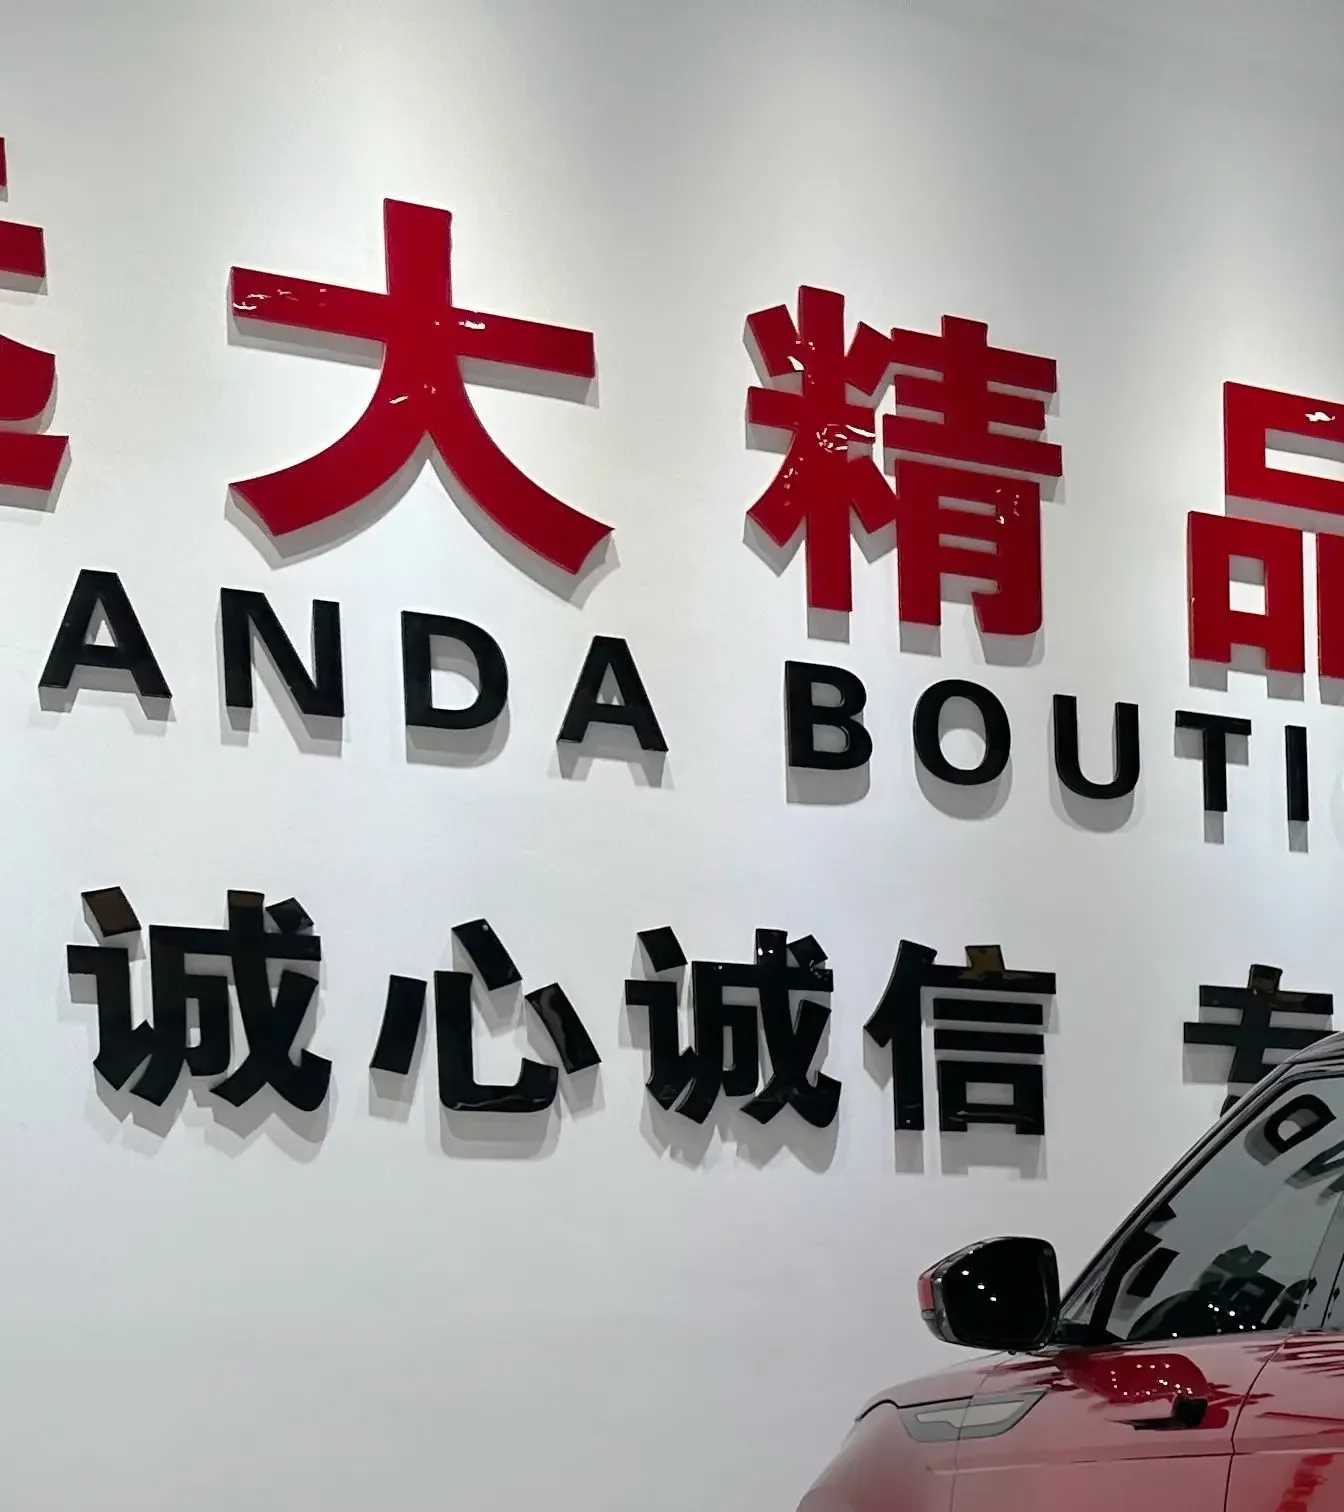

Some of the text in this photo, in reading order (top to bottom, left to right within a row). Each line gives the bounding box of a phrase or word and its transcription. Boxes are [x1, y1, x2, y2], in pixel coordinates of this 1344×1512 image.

[38, 569, 668, 752] ANDA
[67, 887, 1057, 1135] 诚心诚信
